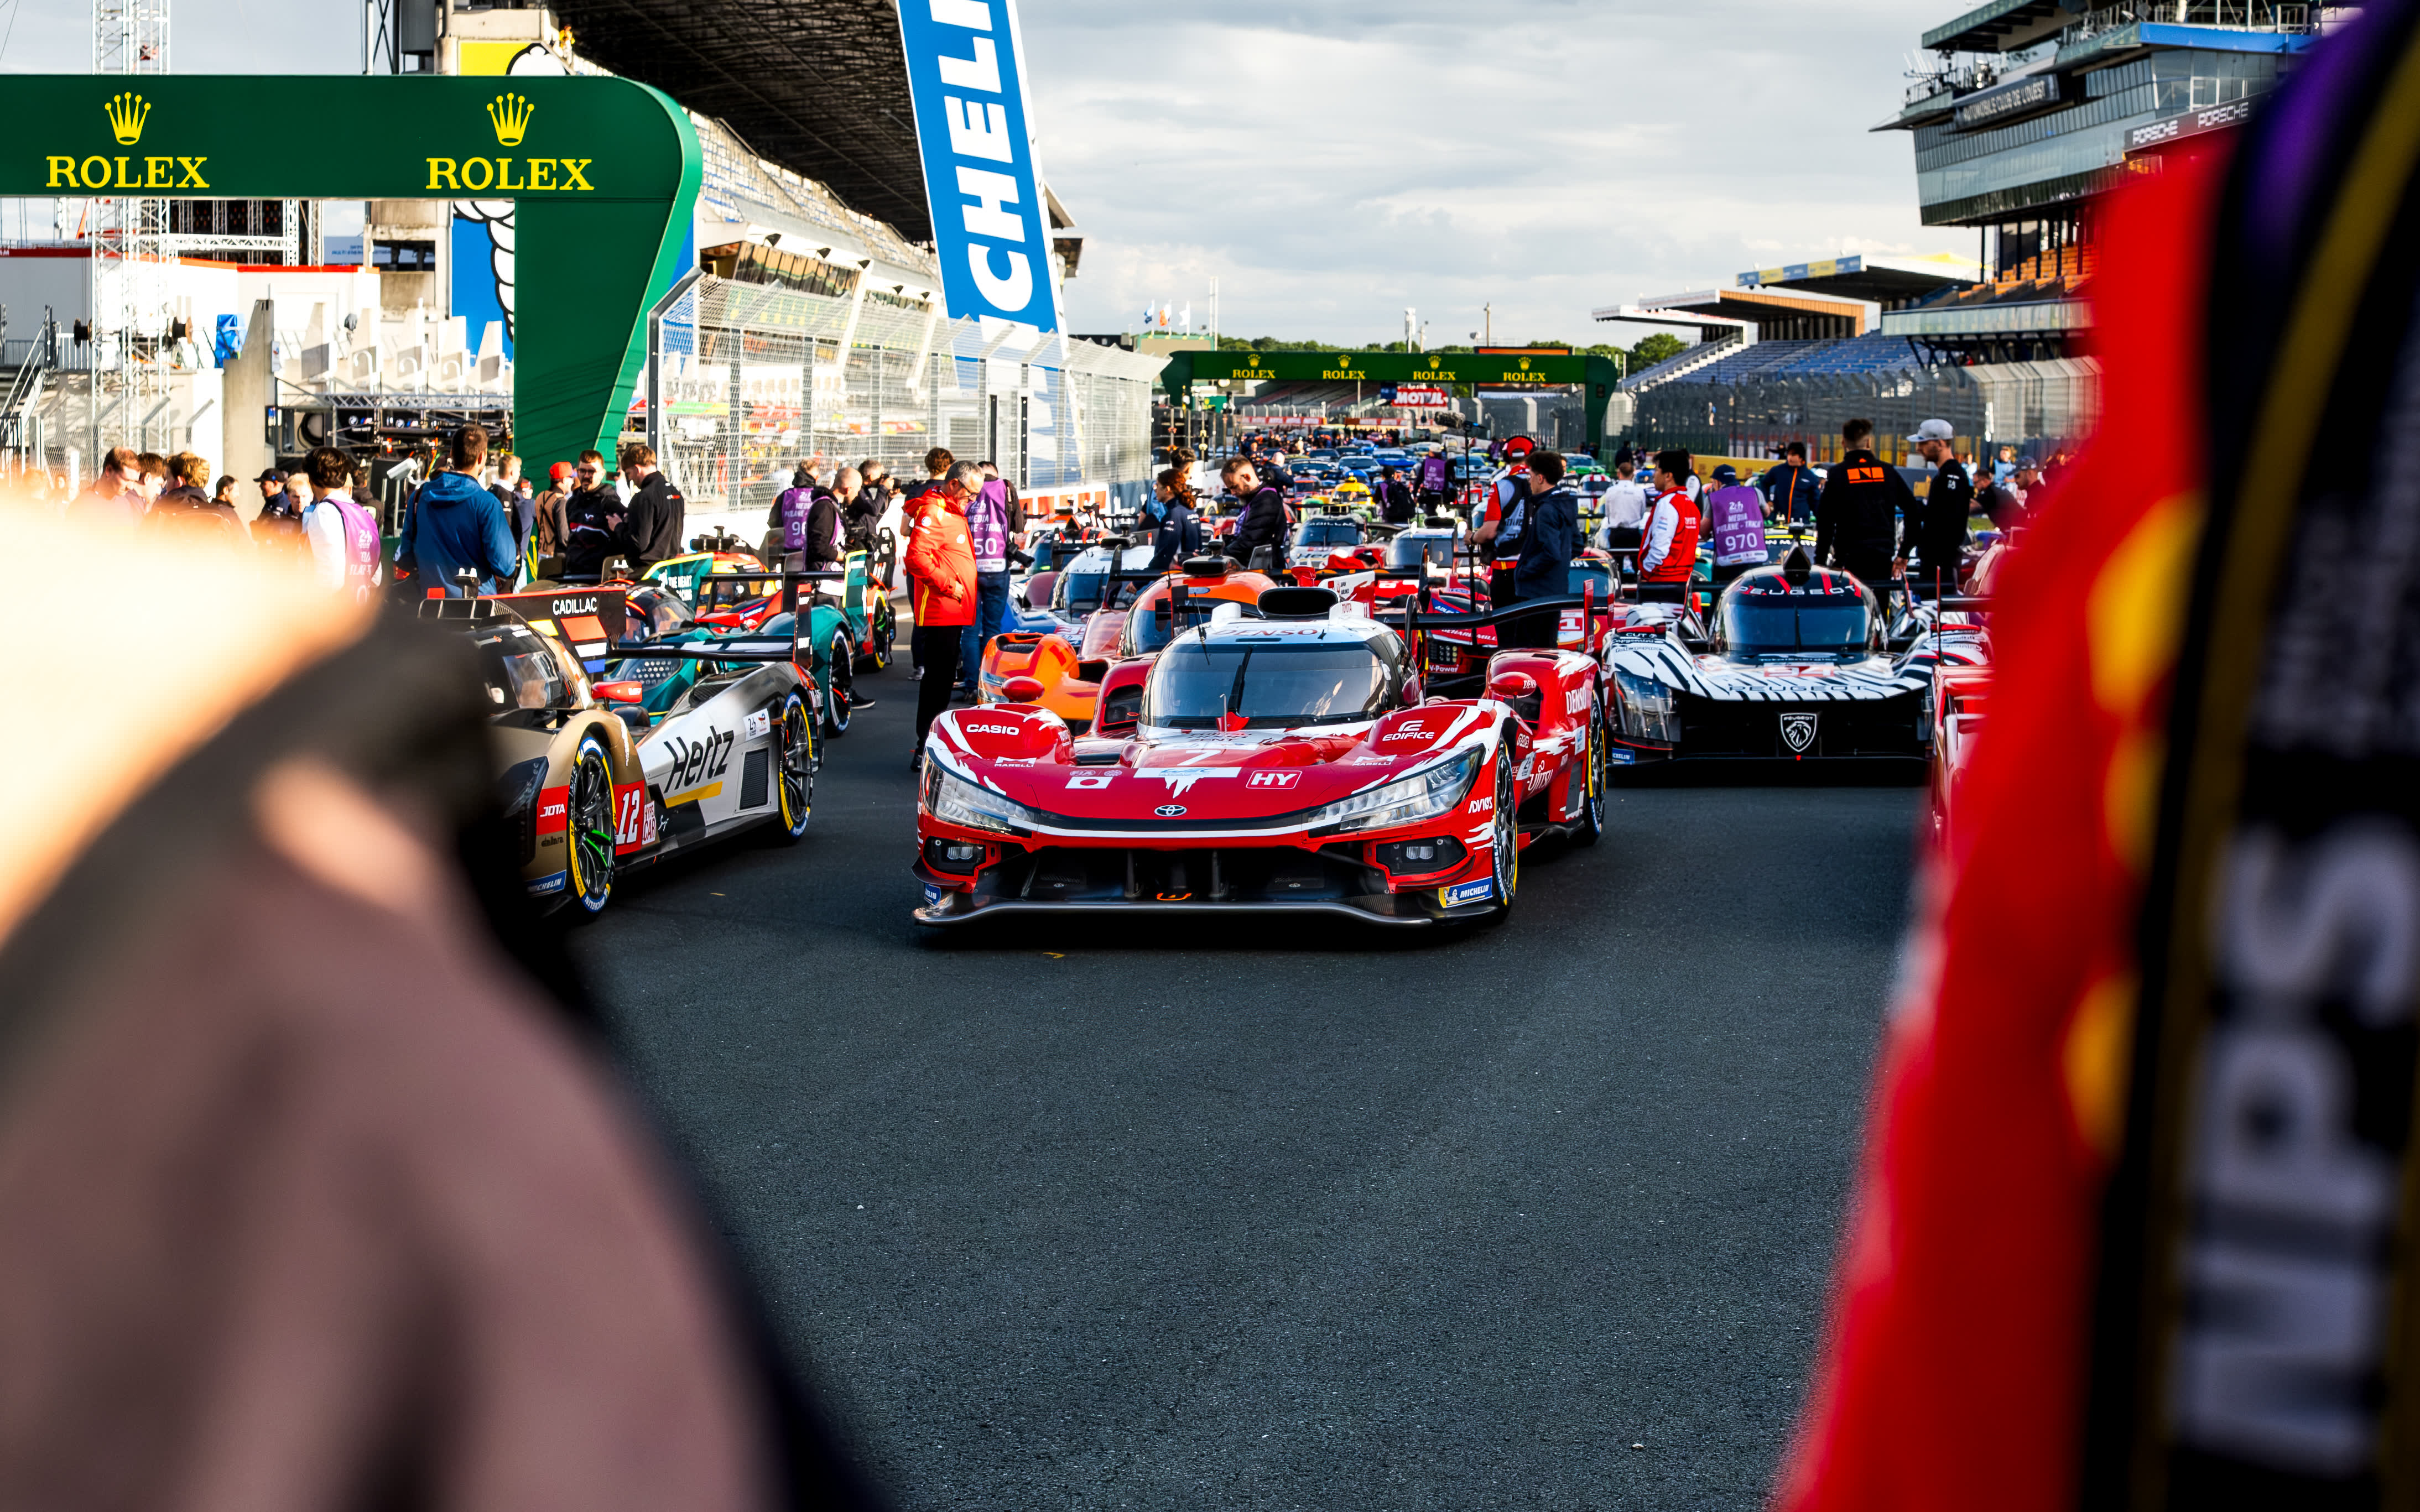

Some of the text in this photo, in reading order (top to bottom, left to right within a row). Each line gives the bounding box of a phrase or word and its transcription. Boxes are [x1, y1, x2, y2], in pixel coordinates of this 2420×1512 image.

[1996, 91, 2012, 111] CLUB
[2012, 88, 2021, 107] DE
[2198, 102, 2249, 128] PORSCHE
[2132, 119, 2178, 145] PORSCHE
[45, 156, 210, 189] ROLEX
[425, 157, 595, 191] ROLEX
[1232, 369, 1276, 379] ROLEX
[1323, 370, 1366, 380] ROLEX
[1413, 371, 1456, 380] ROLEX
[1503, 372, 1545, 382] ROLEX
[1394, 390, 1444, 405] MOTUL
[969, 514, 990, 523] MEDIA
[1725, 533, 1757, 551] 970
[668, 575, 693, 588] THE HEART
[1738, 585, 1856, 596] PEUGEOT
[552, 597, 598, 616] CADILLAC
[1565, 687, 1586, 715] DENSO
[966, 724, 1019, 736] CASIO
[1382, 732, 1435, 742] EDIFICE
[663, 726, 735, 794] Hertz
[1177, 749, 1222, 766] 7
[1250, 773, 1298, 786] HY
[1527, 769, 1554, 796] UJITSU
[540, 803, 566, 817] JOTA
[1467, 796, 1493, 814] ADVICS
[616, 789, 641, 846] 12
[642, 819, 656, 841] CAR
[541, 836, 565, 847] dallara
[1460, 884, 1490, 899] MICHELIN
